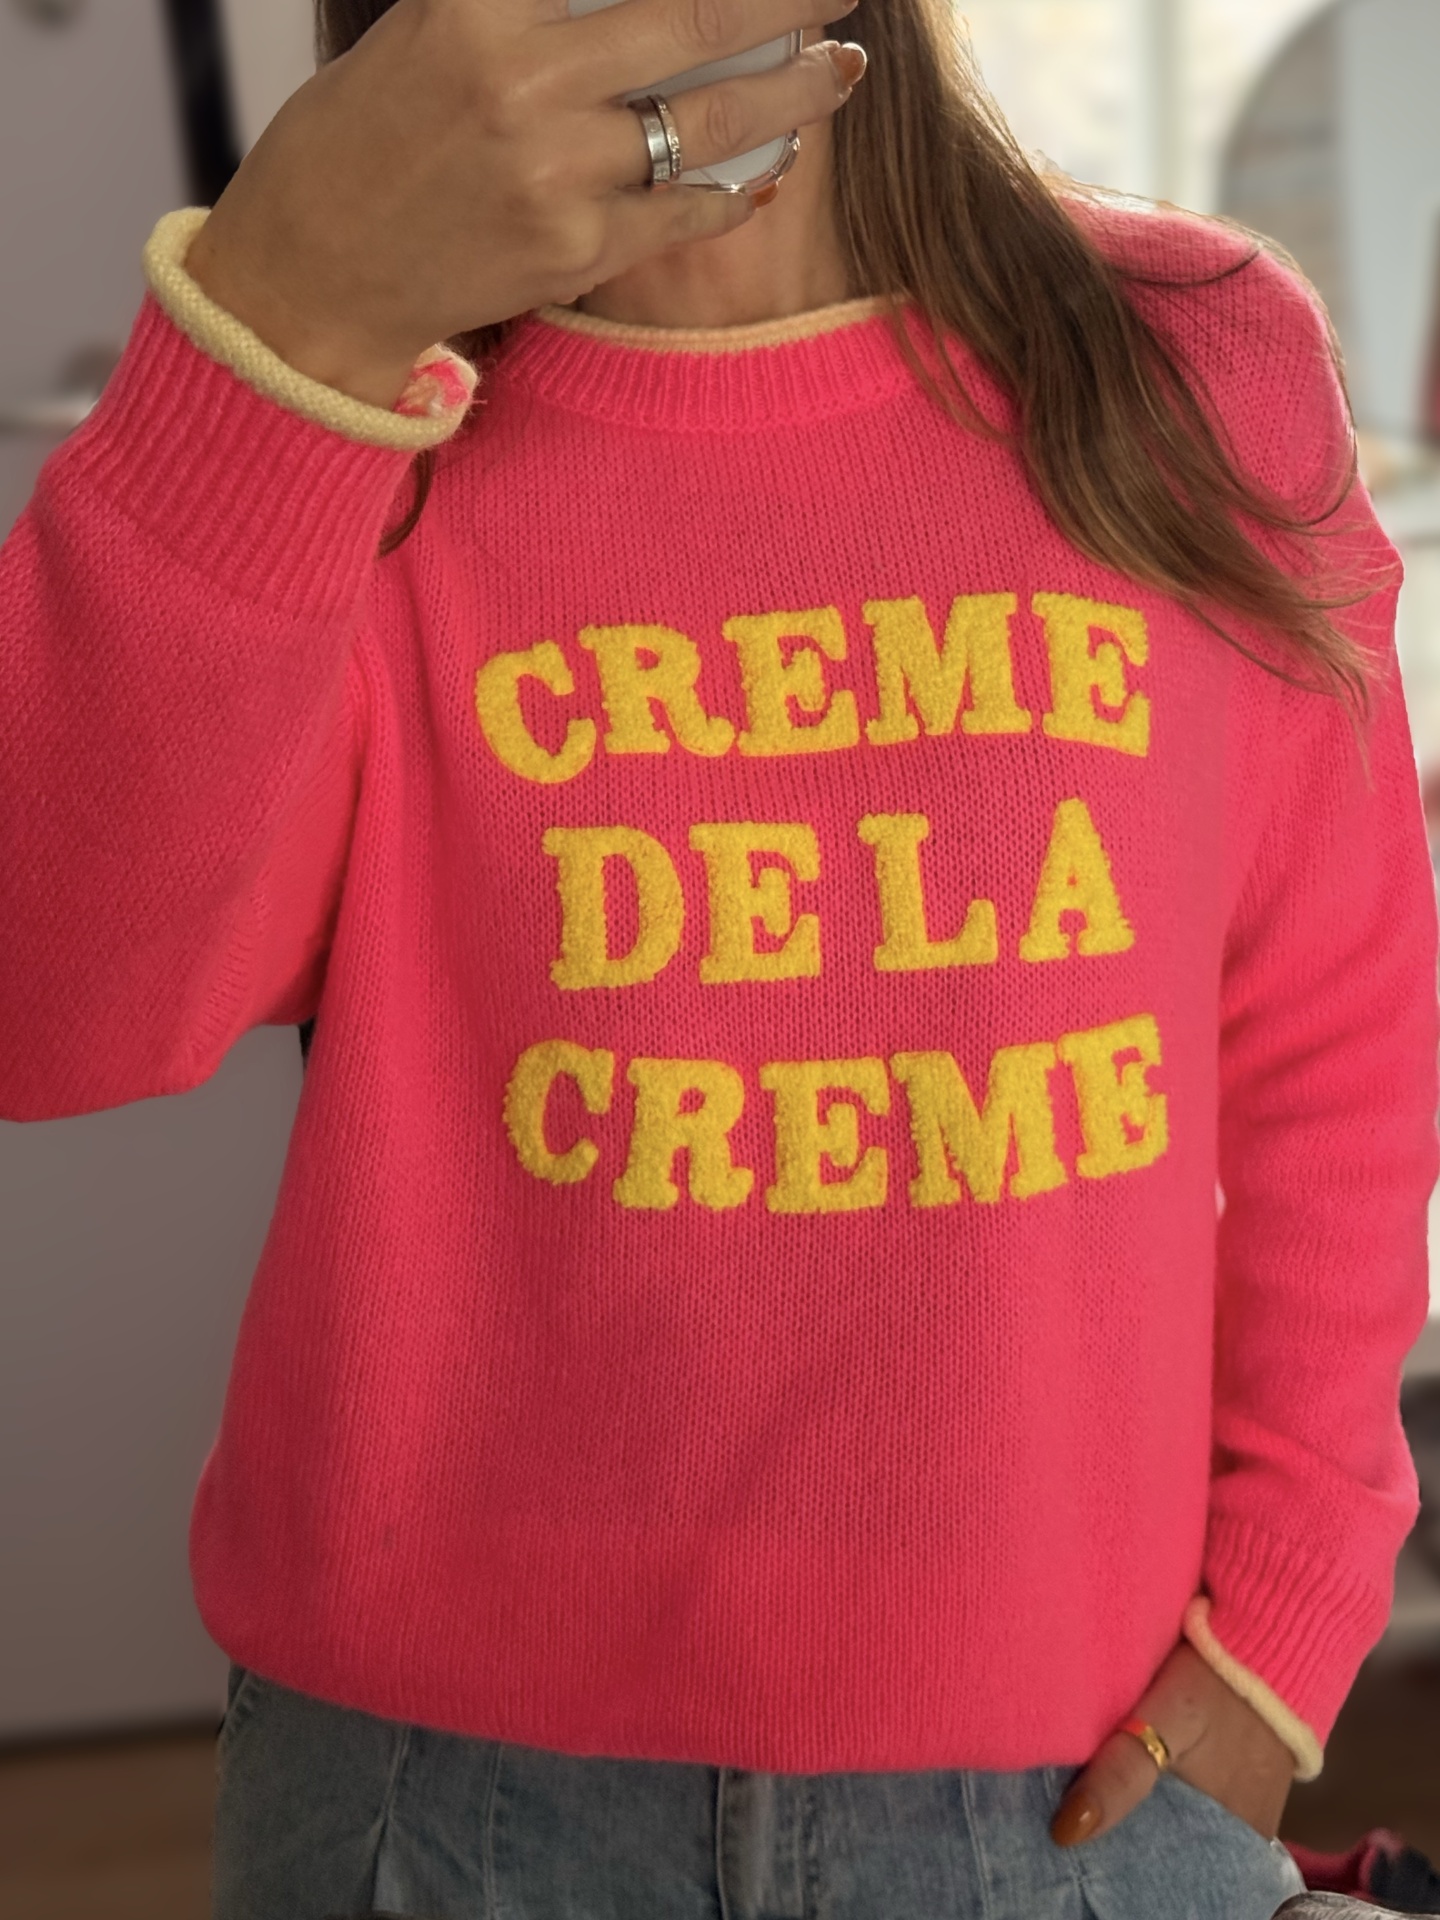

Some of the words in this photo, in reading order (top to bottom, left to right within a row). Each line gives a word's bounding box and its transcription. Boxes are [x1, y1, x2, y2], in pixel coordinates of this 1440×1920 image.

[475, 591, 1151, 785] CREME
[541, 822, 821, 991] DE
[857, 798, 1136, 972] LA
[503, 1013, 1169, 1214] CREME
